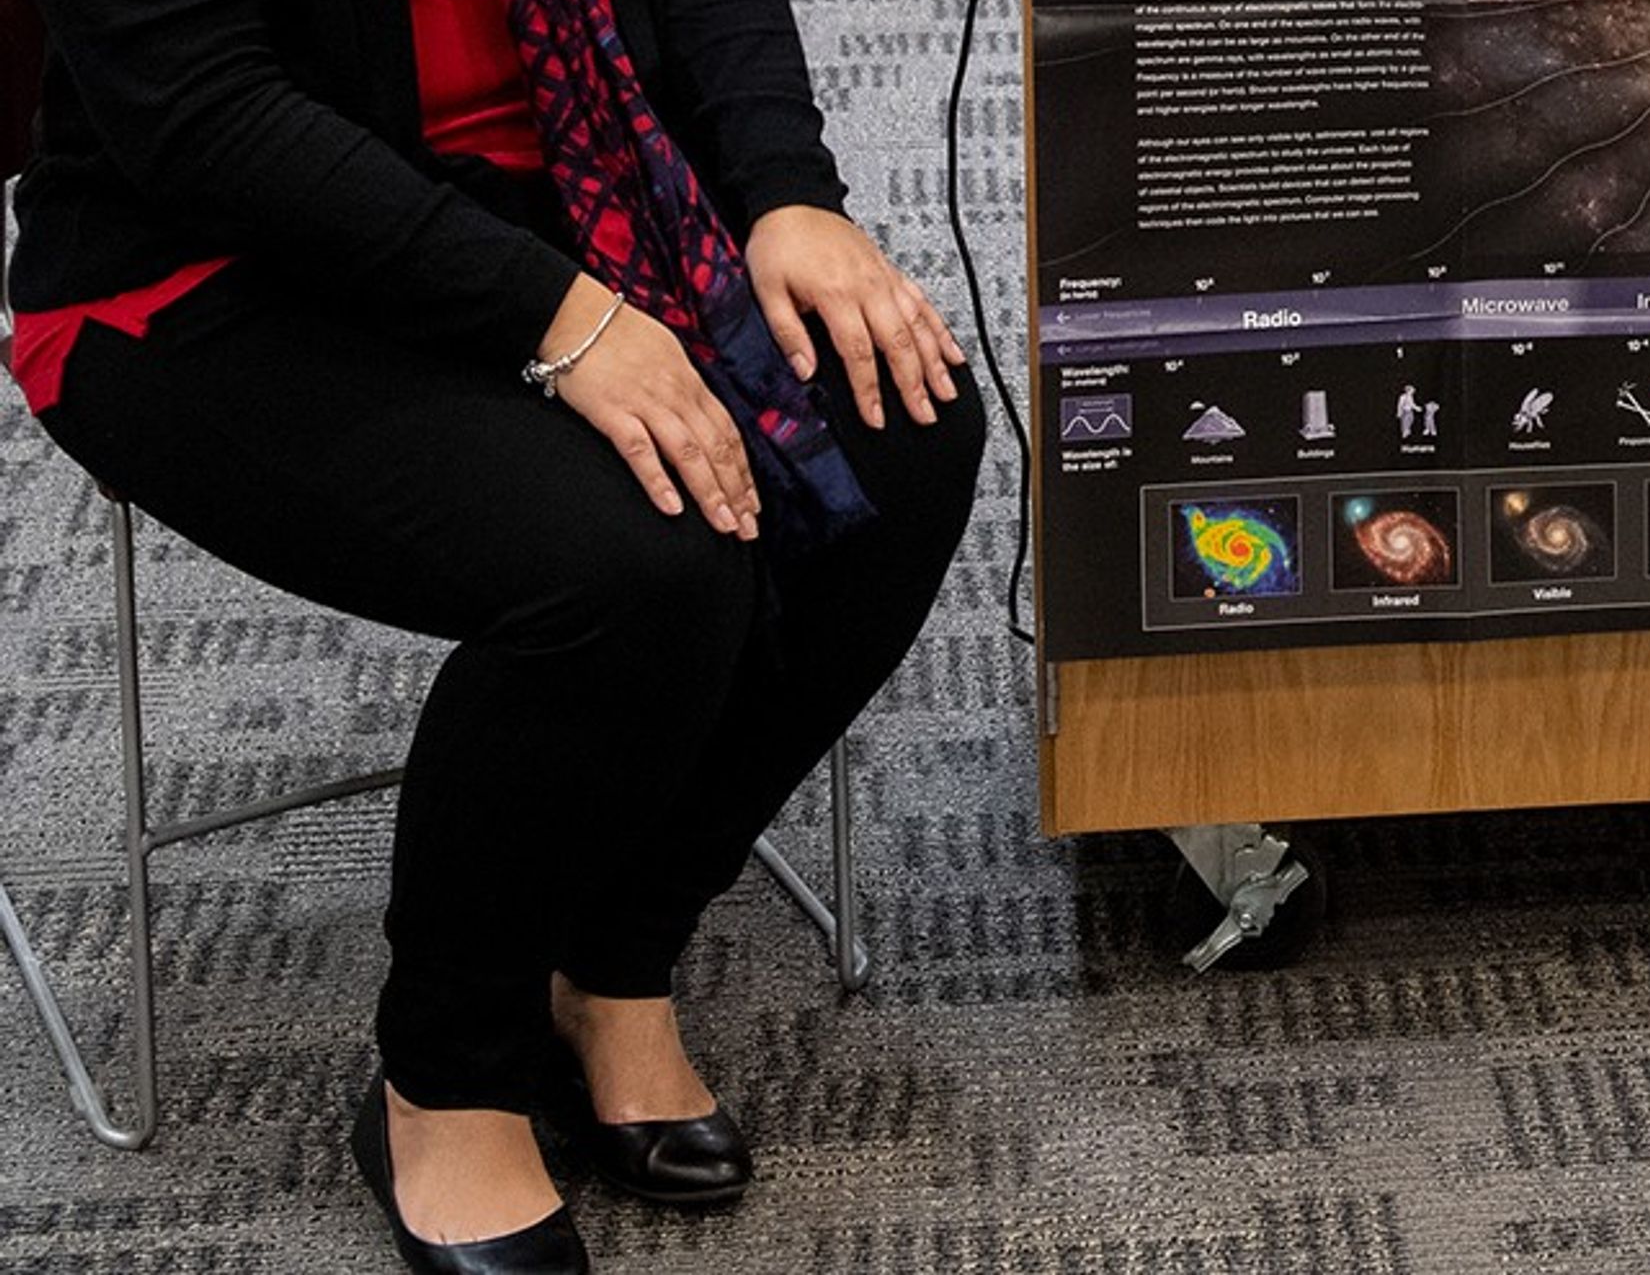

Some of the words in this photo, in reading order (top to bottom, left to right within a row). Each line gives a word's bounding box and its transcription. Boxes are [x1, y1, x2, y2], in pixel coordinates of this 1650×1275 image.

[1059, 277, 1123, 291] Frequency:
[1461, 295, 1571, 315] Microwave
[1242, 308, 1302, 329] Radio
[1060, 364, 1130, 378] Wavelength:
[1062, 449, 1121, 461] Wavelength
[1062, 462, 1080, 472] the
[1082, 461, 1102, 471] size
[1371, 593, 1421, 609] Infrared
[1532, 586, 1573, 603] Visible
[1218, 601, 1255, 617] Radio
